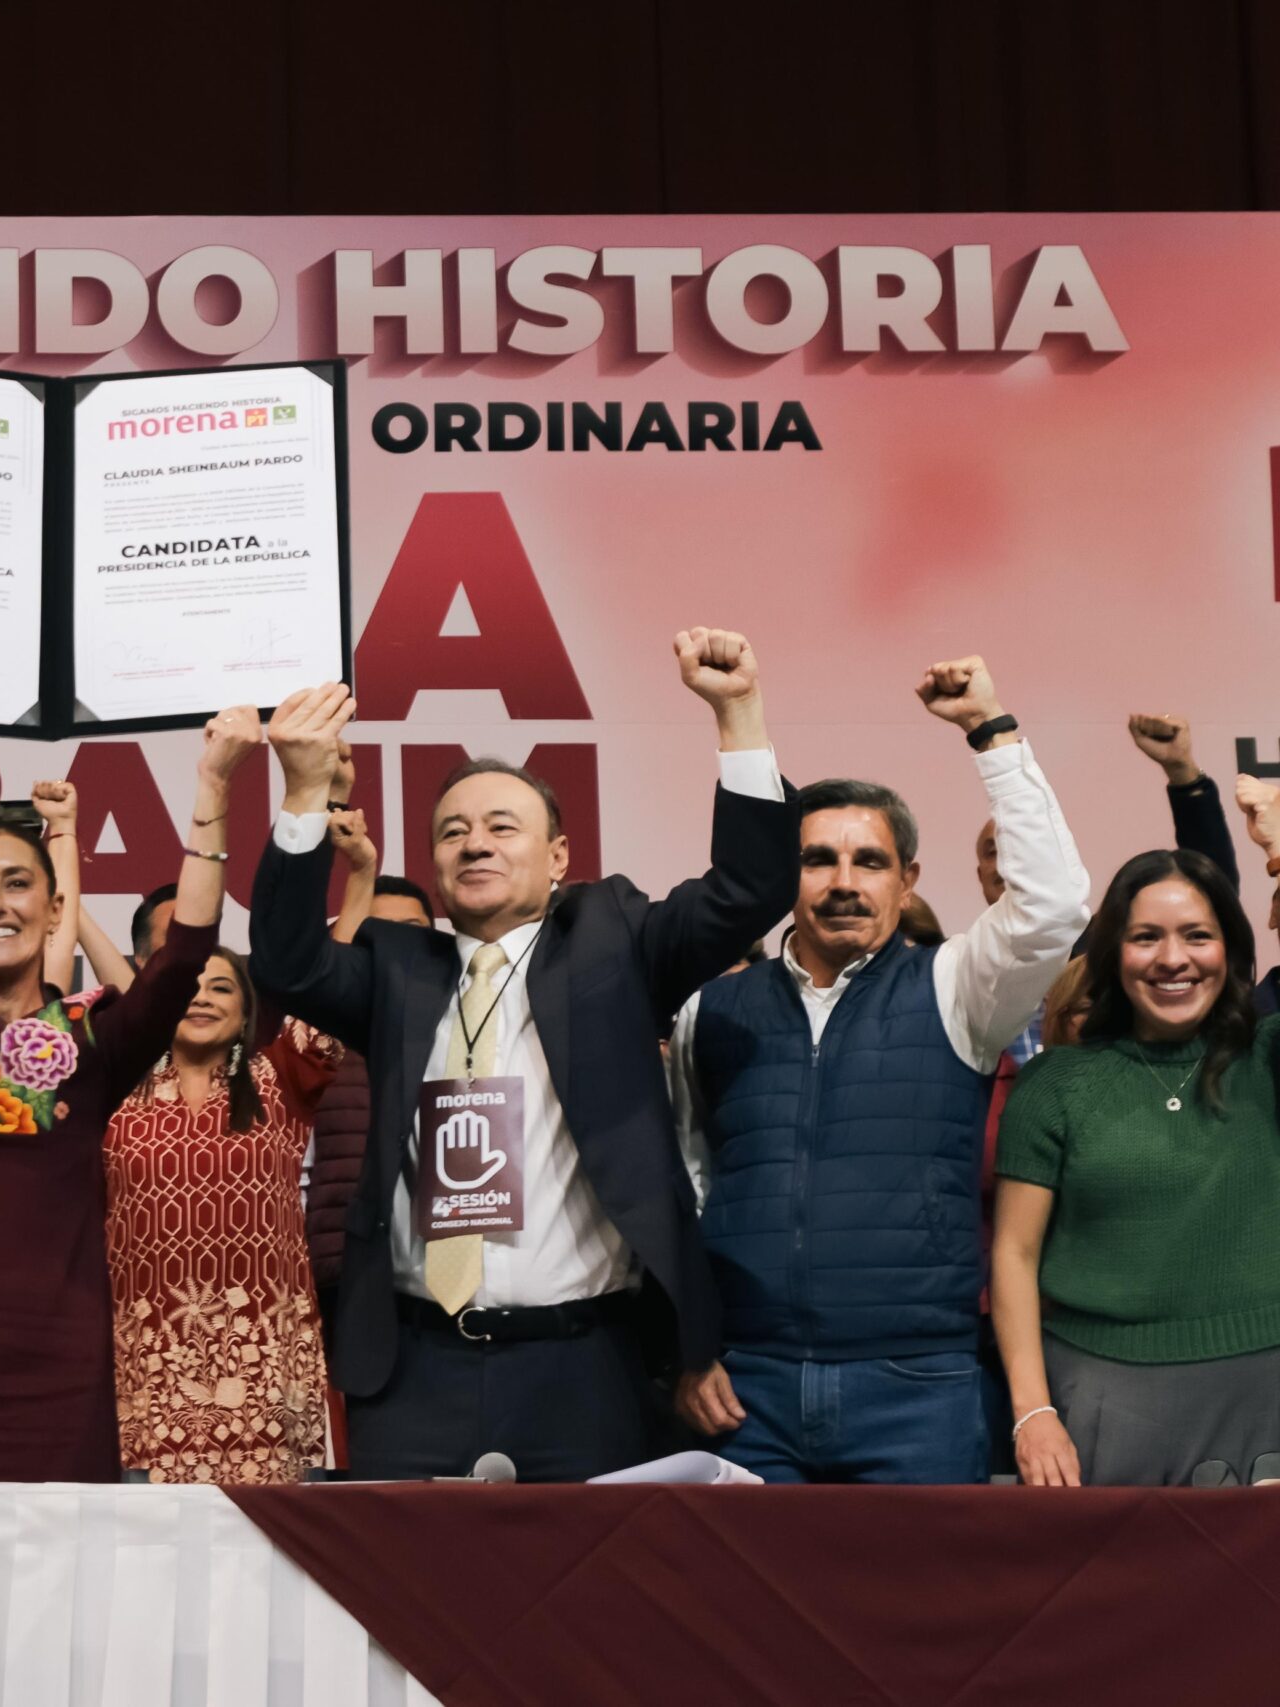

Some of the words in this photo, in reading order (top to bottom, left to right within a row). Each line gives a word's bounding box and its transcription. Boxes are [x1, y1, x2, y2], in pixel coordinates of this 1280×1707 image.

[335, 244, 1131, 356] HISTORIA
[121, 407, 170, 417] SIGAMOS
[172, 401, 229, 412] HACIENDO
[232, 396, 282, 406] HISTORIA
[107, 411, 237, 441] morena
[247, 415, 266, 427] PT
[372, 401, 823, 454] ORDINARIA
[104, 469, 164, 481] CLAUDIA
[169, 460, 250, 475] SHEINBAUM
[255, 454, 303, 467] PARDO
[121, 535, 261, 559] CANDIDATA
[97, 559, 187, 574] PRESIDENCIA
[191, 557, 209, 567] DE
[213, 555, 230, 565] LA
[235, 549, 312, 564] REPÚBLICA
[436, 1091, 507, 1109] morena
[449, 1190, 511, 1208] SESIÓN
[431, 1219, 470, 1229] CONSEJO
[470, 1217, 513, 1227] NACIONAL
